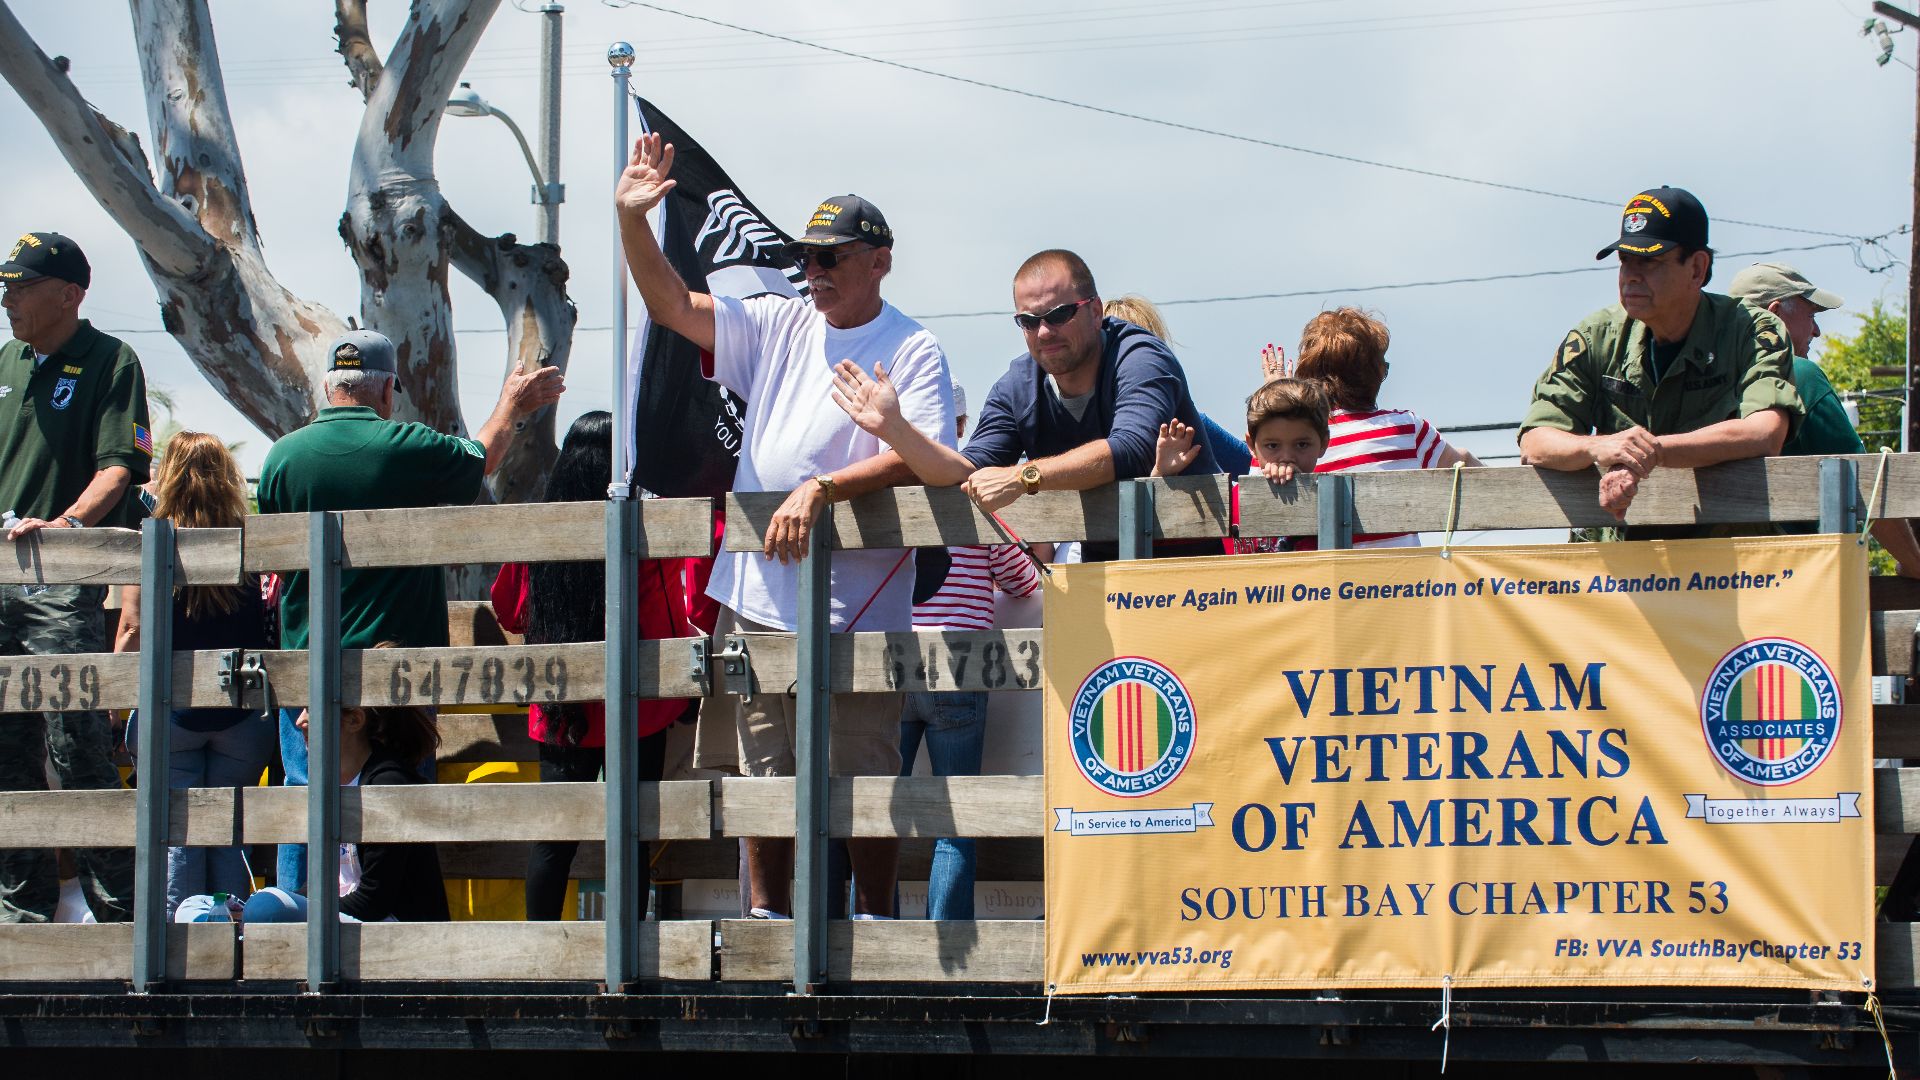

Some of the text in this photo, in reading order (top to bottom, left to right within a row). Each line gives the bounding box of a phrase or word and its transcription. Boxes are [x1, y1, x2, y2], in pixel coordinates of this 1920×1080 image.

[714, 415, 738, 449] YOU
[1181, 587, 1238, 612] Again
[1245, 584, 1285, 604] Will
[1291, 583, 1332, 601] One
[1338, 578, 1456, 600] Generation
[1464, 577, 1485, 596] of
[1489, 577, 1581, 596] Veterans
[1587, 573, 1680, 593] Abandon
[390, 656, 568, 705] 647839
[883, 640, 1040, 689] 64783
[1708, 645, 1836, 722] VIETNAM VETERANS
[0, 664, 100, 711] 7839
[1075, 663, 1190, 738] VIETNAM VETERANS
[1281, 662, 1608, 719] VIETNAM
[1718, 722, 1826, 737] ASSOCIATES
[1263, 728, 1631, 786] VETERANS
[1720, 742, 1745, 763] OF
[1085, 756, 1182, 791] OF AMERICA
[1075, 816, 1192, 830] In Service to America
[1231, 795, 1669, 853] OF AMERICA
[1708, 804, 1836, 820] Together Always
[1179, 880, 1731, 922] SOUTH BAY CHAPTER 53
[1081, 946, 1233, 969] www.vva53.org
[1554, 938, 1863, 963] FB: VVA SouthBayChapter 53
